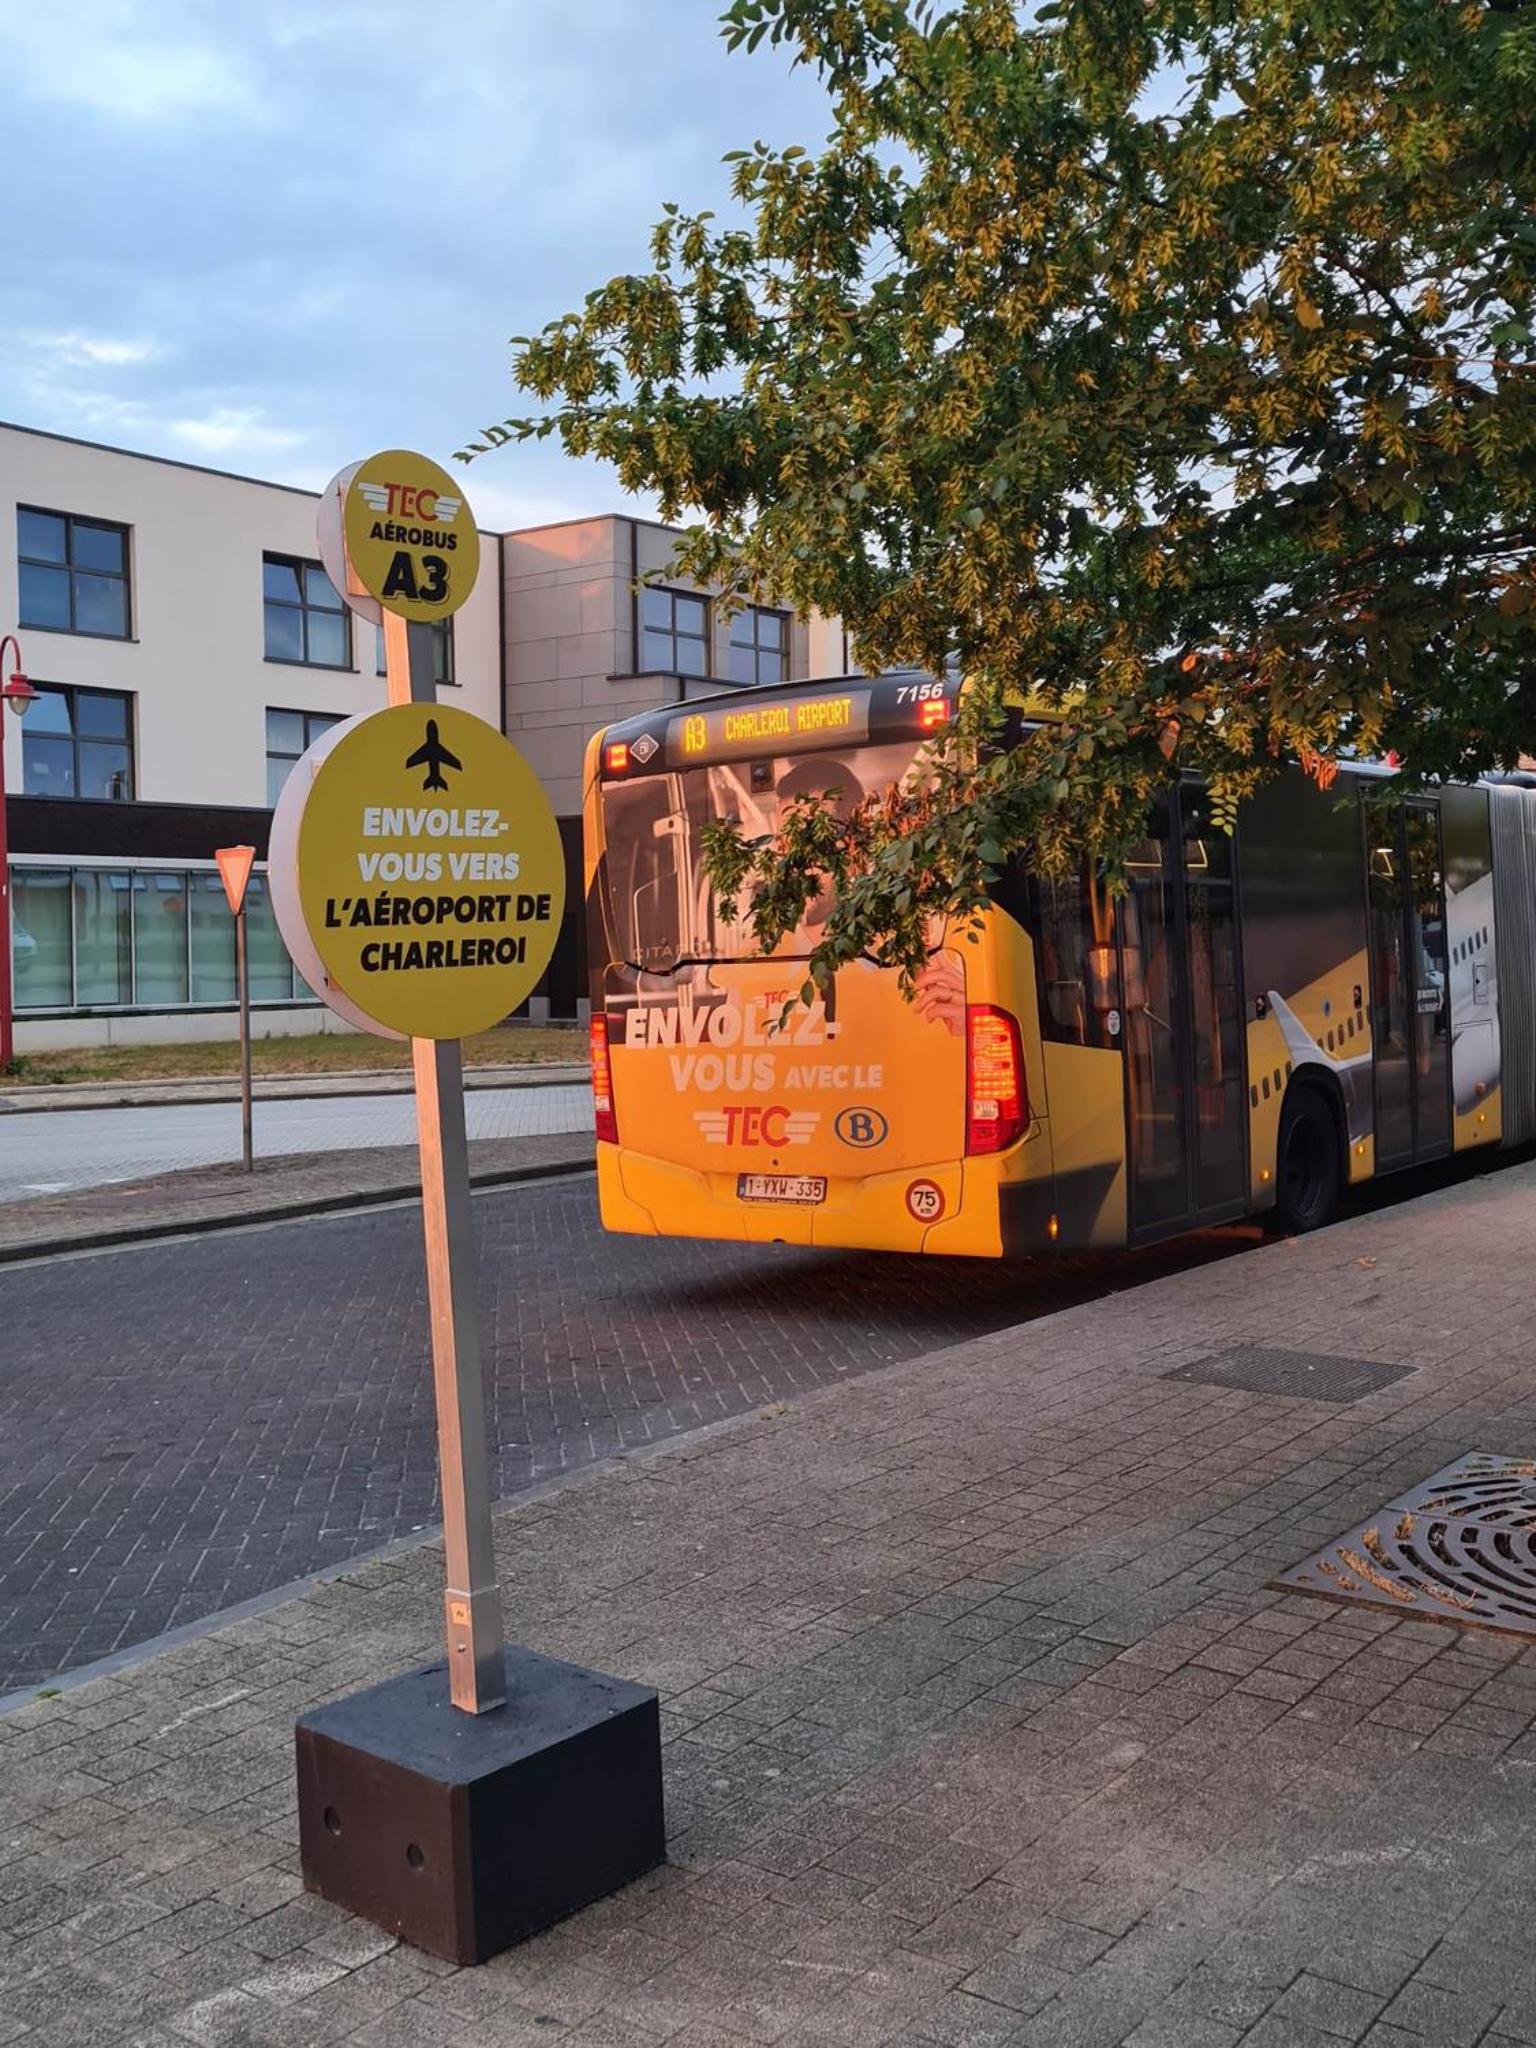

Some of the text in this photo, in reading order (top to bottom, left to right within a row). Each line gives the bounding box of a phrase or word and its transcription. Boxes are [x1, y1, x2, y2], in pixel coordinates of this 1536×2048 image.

[384, 484, 439, 521] TEC
[370, 520, 457, 550] AÉROBUS
[382, 551, 450, 604] A3
[896, 683, 944, 703] 7156
[685, 715, 707, 751] A3
[725, 708, 791, 739] CHARLEROI
[798, 699, 851, 730] AIRPORT
[363, 807, 508, 837] ENVOLEZ-
[357, 853, 520, 881] VOUS VERS
[325, 891, 551, 928] L'AÉROPORT DE
[361, 937, 526, 972] CHARLEROI
[669, 1053, 883, 1092] VOUS AVEC LE
[722, 1105, 791, 1147] TEC
[914, 1191, 936, 1207] 75
